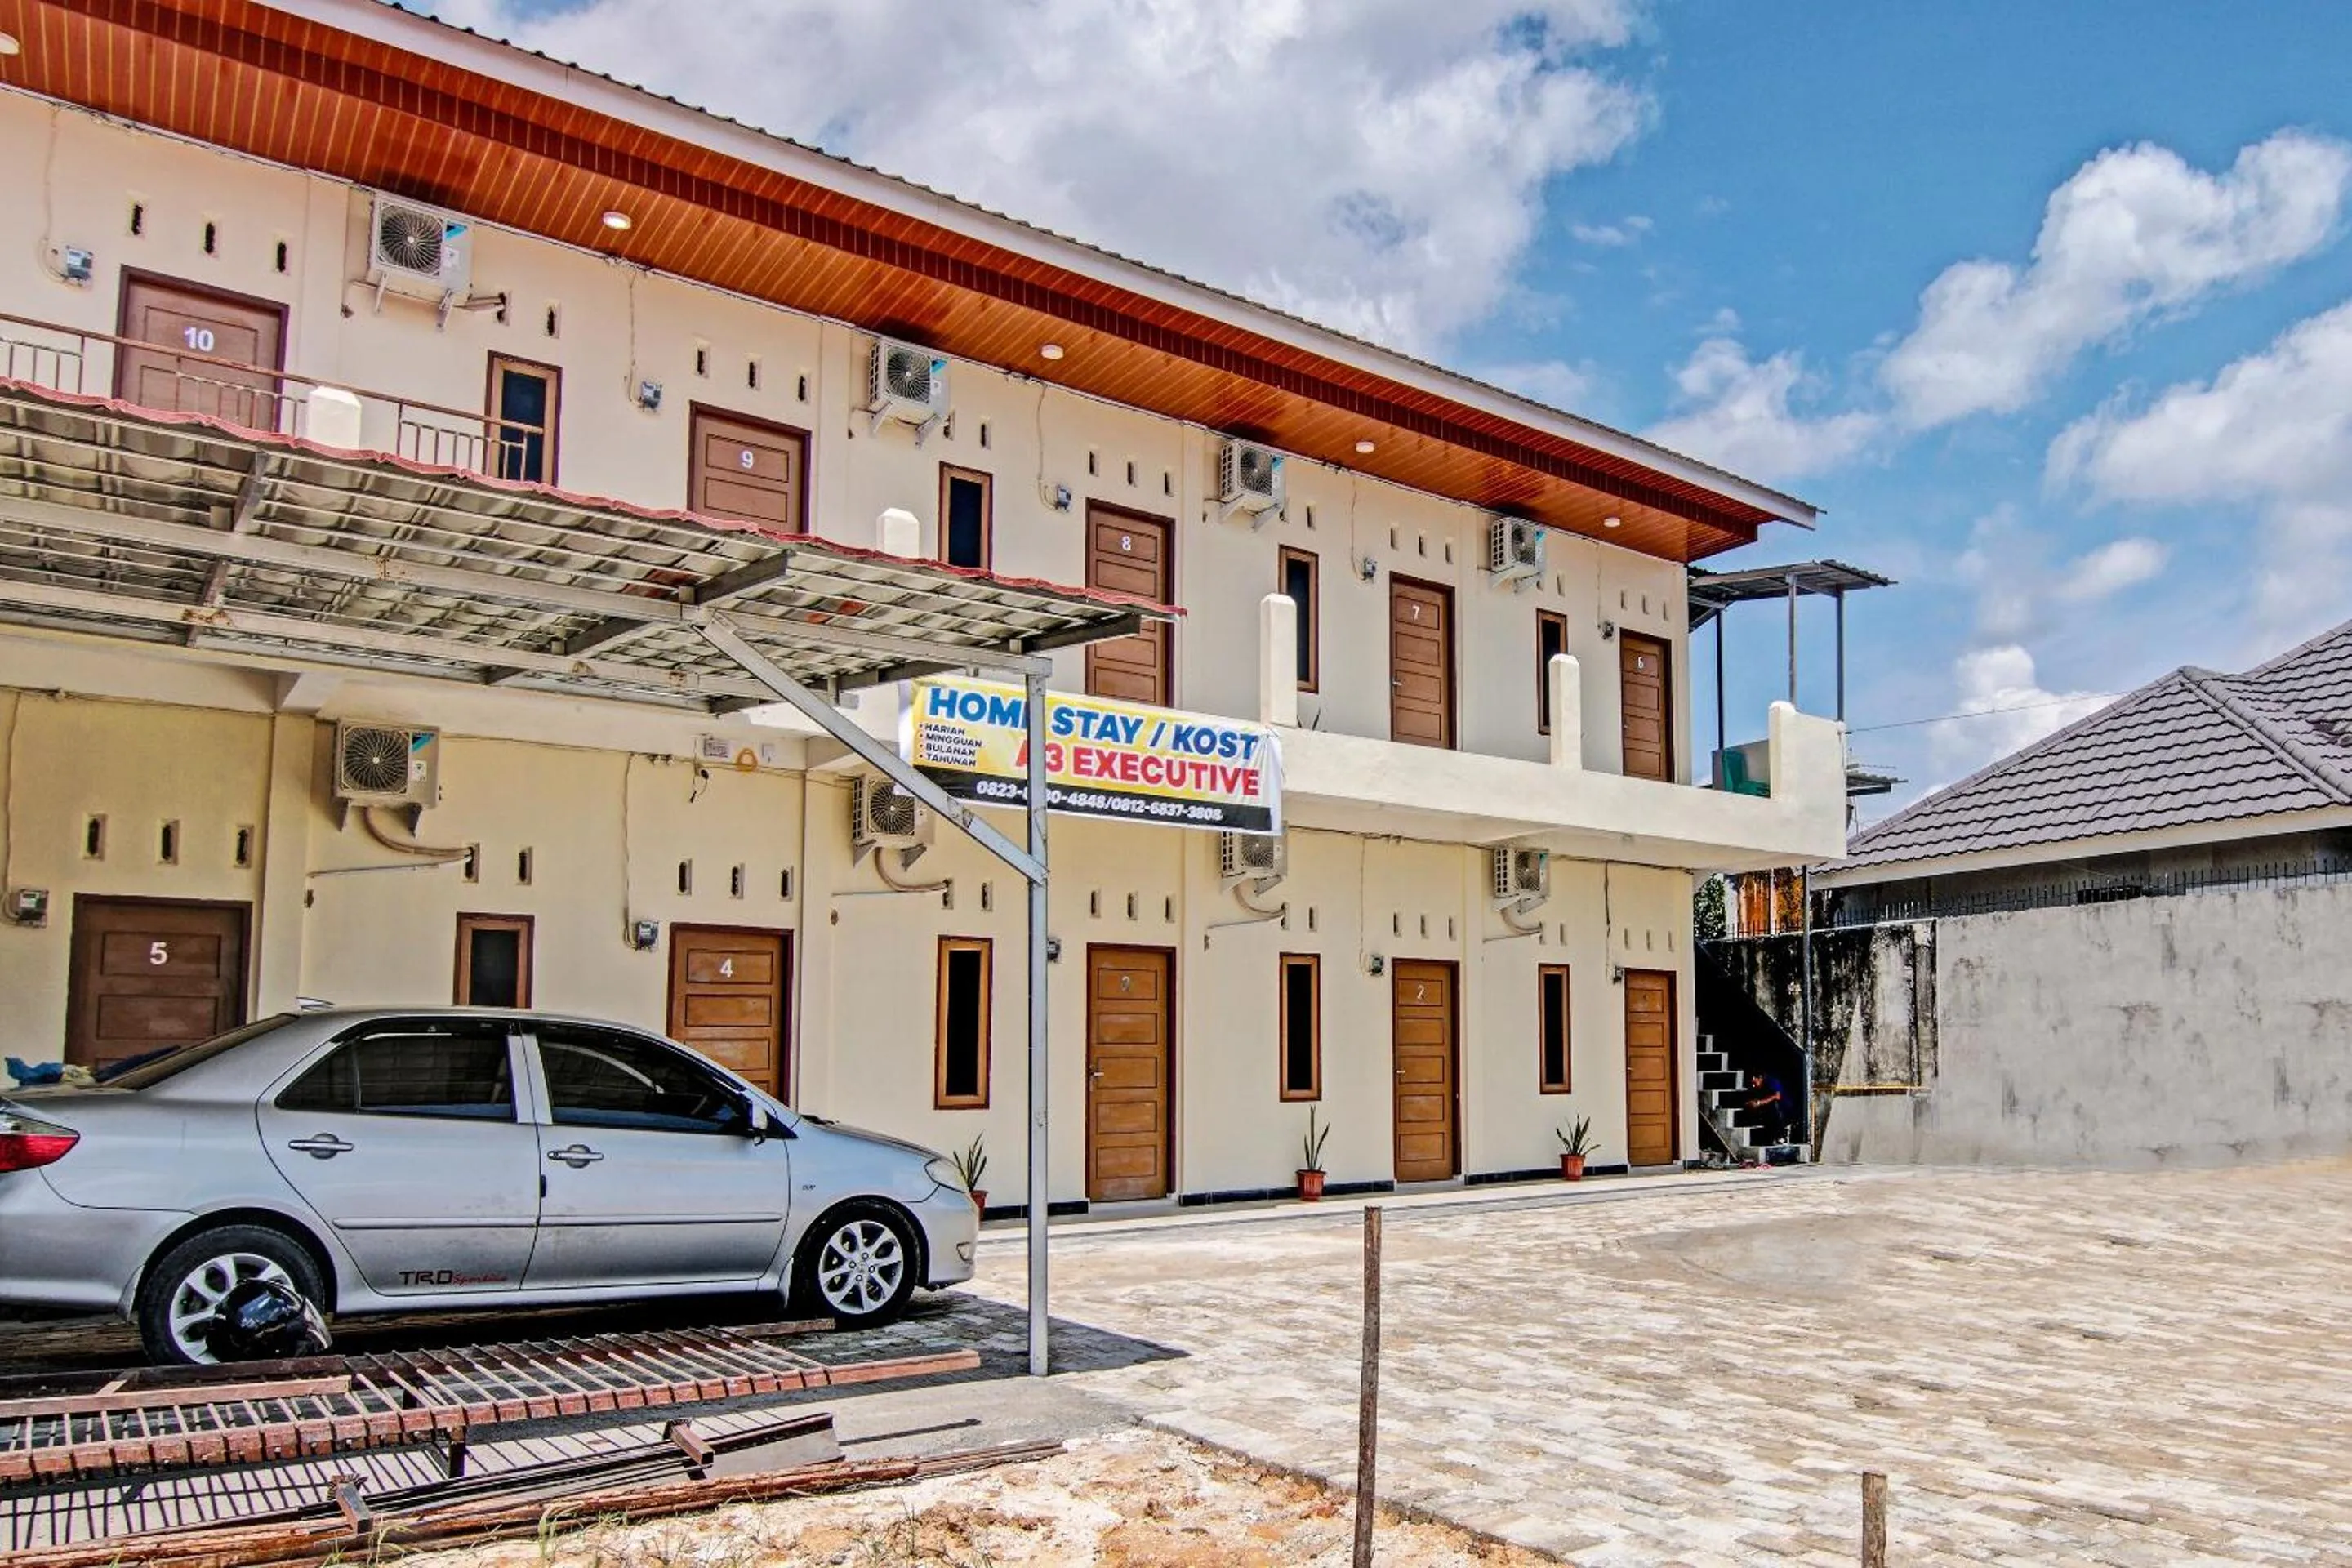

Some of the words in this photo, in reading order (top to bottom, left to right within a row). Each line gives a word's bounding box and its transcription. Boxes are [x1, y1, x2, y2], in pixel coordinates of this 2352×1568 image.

[184, 327, 214, 352] 10
[742, 450, 753, 469] 9
[1122, 535, 1131, 551] 8
[1412, 604, 1420, 621] 7
[1637, 656, 1644, 669] 6
[924, 723, 965, 735] HARIAN
[1052, 707, 1143, 744] STAY
[1172, 724, 1259, 760] KOST
[926, 733, 982, 747] MINGGUAN
[926, 743, 976, 756] BULANAN
[926, 752, 977, 766] TAHUNAN
[1074, 747, 1259, 795] EXECUTIVE
[149, 941, 167, 965] 5
[719, 958, 733, 978] 4
[399, 1270, 452, 1285] TRD
